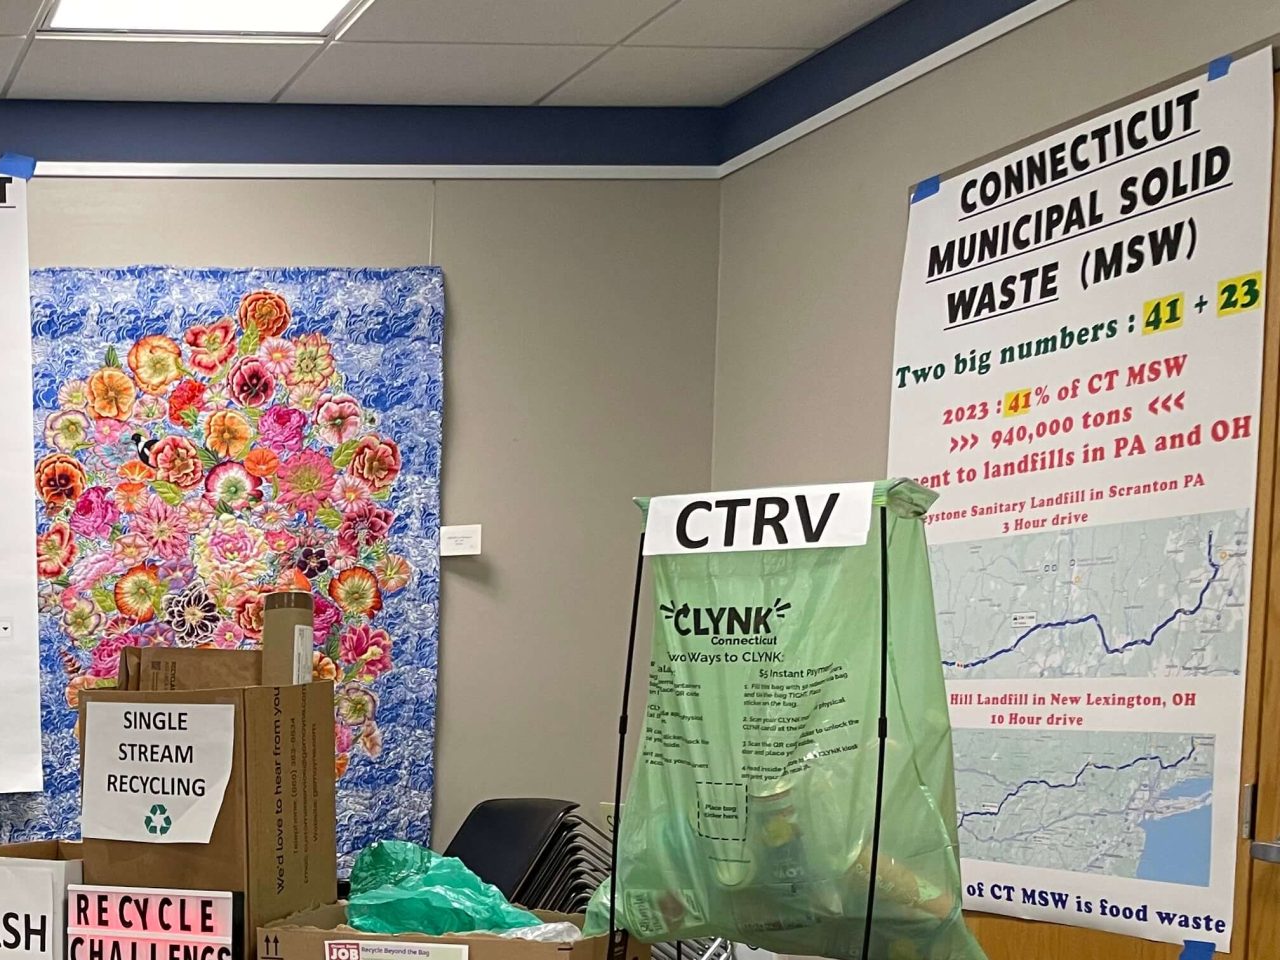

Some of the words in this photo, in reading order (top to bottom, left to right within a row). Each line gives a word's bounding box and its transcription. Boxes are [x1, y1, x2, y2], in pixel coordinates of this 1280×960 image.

[960, 88, 1200, 214] CONNECTICUT
[927, 190, 1103, 278] MUNICIPAL
[1120, 145, 1232, 215] SOLID
[946, 261, 1059, 324] WASTE
[1080, 216, 1197, 289] (MSW)
[896, 363, 946, 389] Two
[954, 347, 992, 377] big
[1000, 315, 1118, 365] numbers
[1144, 298, 1181, 332] 41
[1220, 278, 1261, 310] 23
[942, 401, 989, 425] 2023
[1088, 370, 1118, 395] CT
[1125, 354, 1189, 387] MSW
[990, 415, 1074, 450] 940,000
[1082, 406, 1133, 429] tons
[983, 446, 1075, 480] landfills
[1114, 433, 1145, 459] PA
[1154, 424, 1202, 452] and
[1211, 415, 1253, 443] OH
[971, 498, 1026, 519] Sanitary
[1030, 490, 1085, 511] Landfill
[1108, 477, 1178, 499] Scranton
[1183, 473, 1205, 488] PA
[675, 491, 840, 549] CTRV
[1014, 516, 1048, 532] Hour
[1051, 511, 1088, 527] drive
[673, 602, 774, 636] CLYNK
[711, 635, 778, 646] Connecticut
[688, 652, 721, 665] Ways
[724, 653, 738, 663] to
[742, 652, 784, 663] CLYNK:
[770, 669, 804, 678] Instant
[950, 693, 972, 706] Hill
[977, 693, 1029, 706] Landfill
[1050, 693, 1081, 706] New
[1086, 693, 1166, 708] Lexington,
[1172, 693, 1197, 706] OH
[124, 711, 188, 730] SINGLE
[1008, 713, 1042, 725] Hour
[1046, 713, 1083, 726] drive
[118, 743, 194, 763] STREAM
[273, 720, 282, 756] from
[107, 774, 206, 797] RECYCLING
[274, 761, 283, 795] hear
[274, 799, 283, 814] to
[274, 819, 284, 851] love
[77, 894, 214, 933] RECYCLE
[990, 884, 1015, 901] CT
[1021, 888, 1070, 909] MSW
[1099, 898, 1148, 922] food
[1156, 909, 1227, 933] waste
[331, 948, 359, 960] JOB
